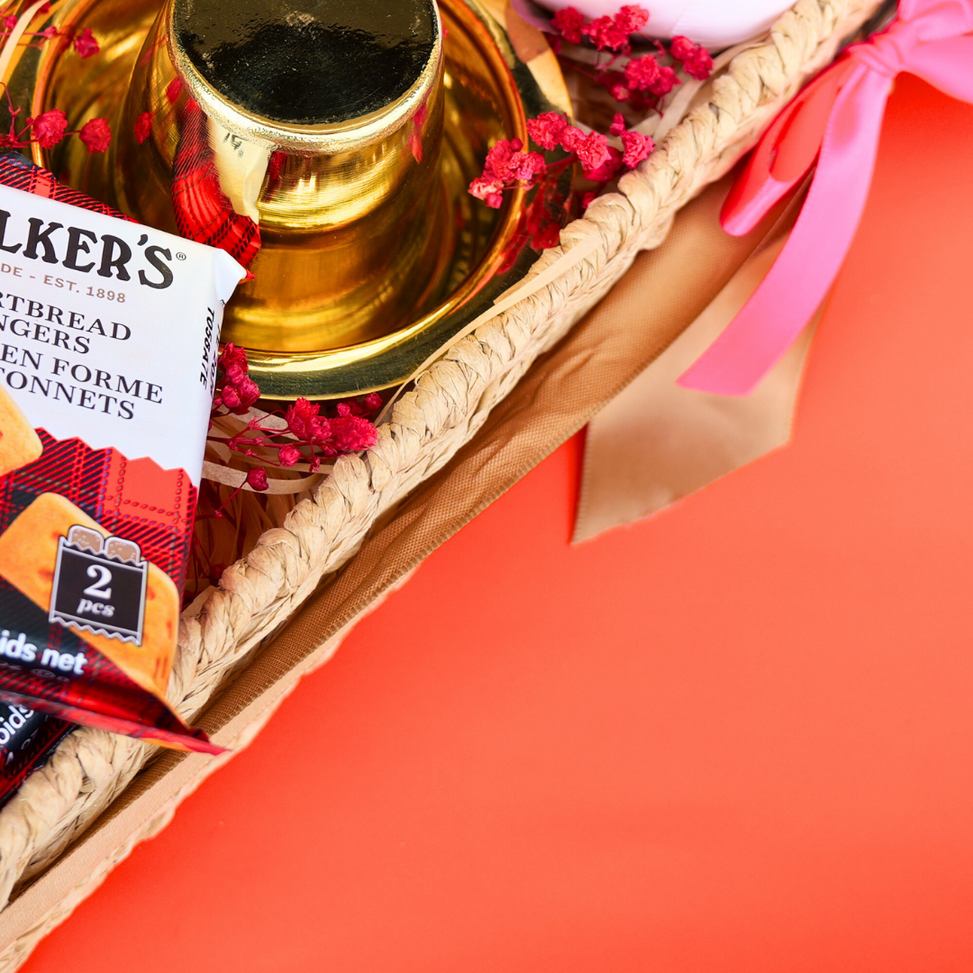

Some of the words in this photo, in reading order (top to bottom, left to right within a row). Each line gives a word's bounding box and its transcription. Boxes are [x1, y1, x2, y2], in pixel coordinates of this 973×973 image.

[43, 275, 80, 295] EST.
[86, 287, 127, 304] 1898
[0, 343, 49, 370] EN
[52, 357, 163, 405] FORME
[83, 564, 113, 600] 2
[76, 598, 115, 617] pcs
[41, 647, 87, 675] net
